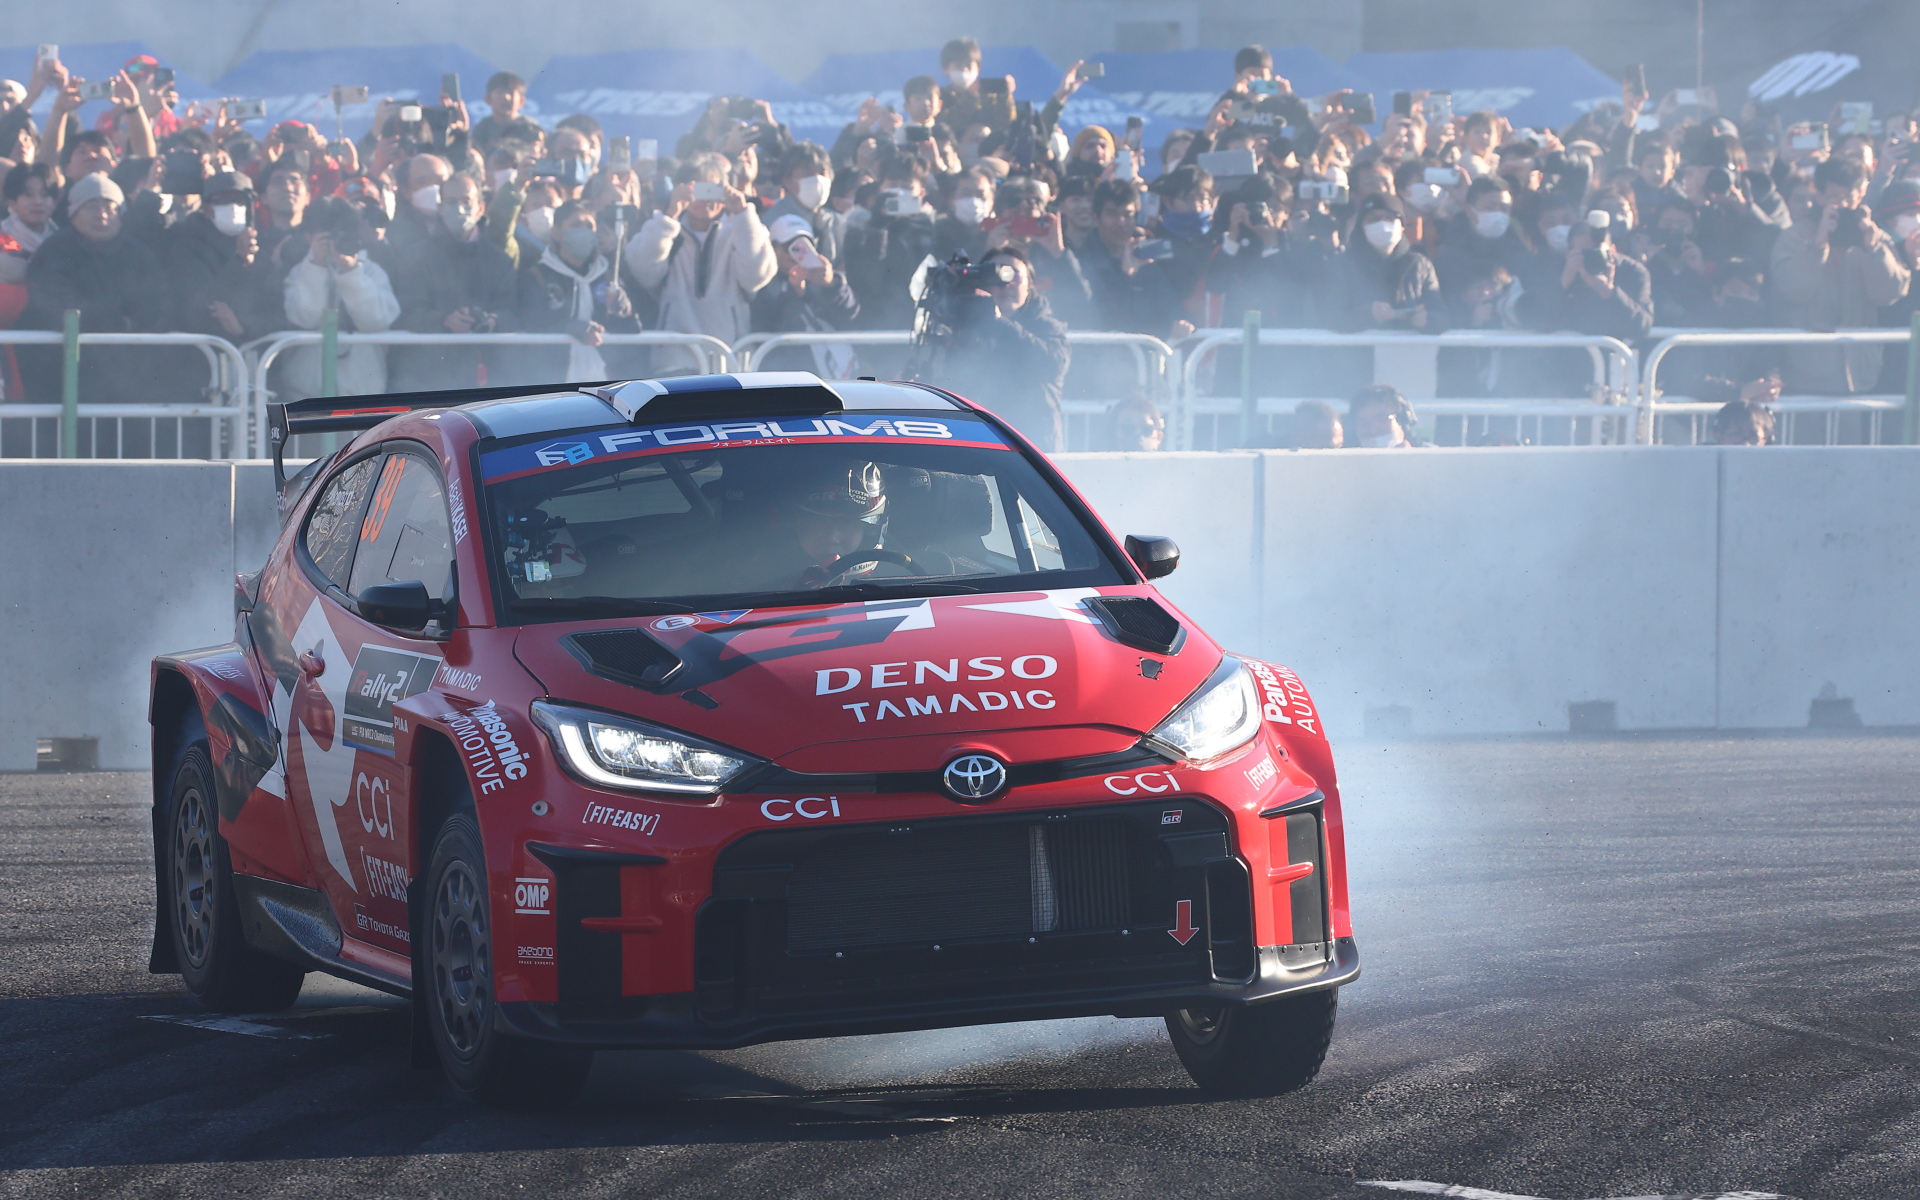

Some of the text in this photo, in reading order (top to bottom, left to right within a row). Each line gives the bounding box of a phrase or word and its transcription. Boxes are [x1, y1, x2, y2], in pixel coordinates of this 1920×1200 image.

[599, 419, 953, 453] FORUM8
[710, 437, 796, 448] フォーラムエイト
[350, 669, 408, 709] Rally2
[438, 666, 482, 692] TAMADIC
[815, 654, 1059, 697] DENSO
[842, 688, 1057, 724] TAMADIC
[515, 883, 549, 908] OMP
